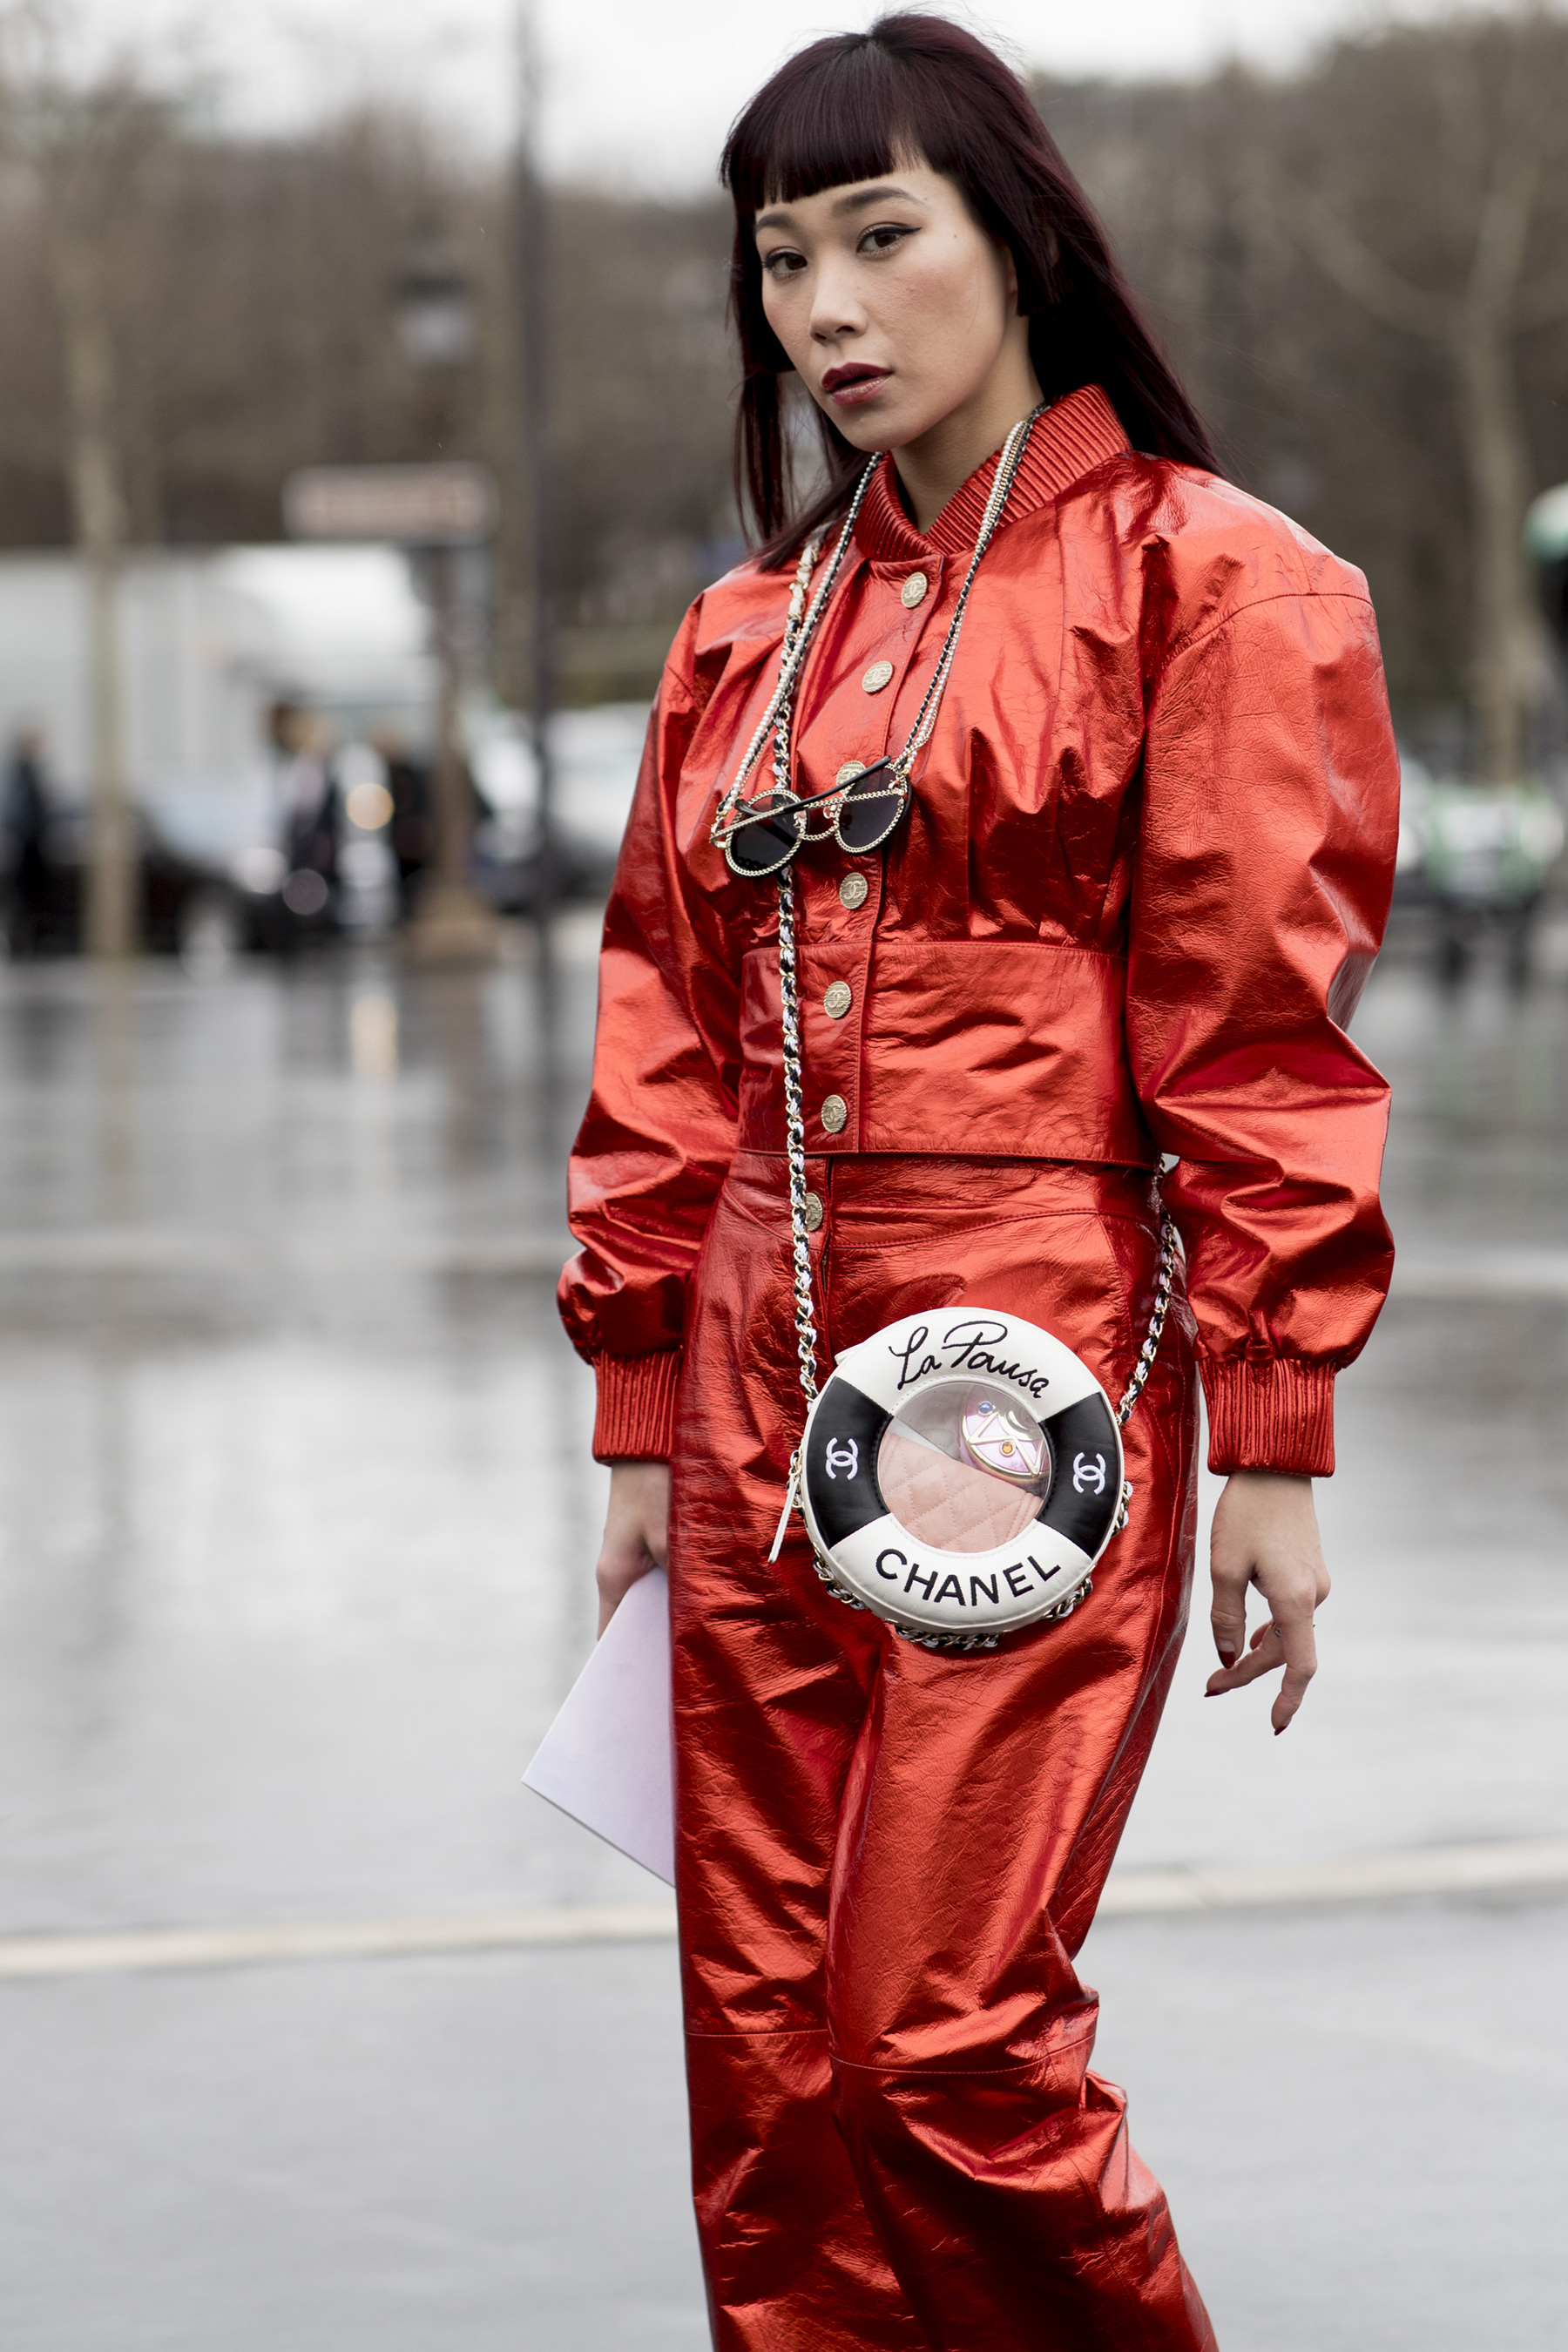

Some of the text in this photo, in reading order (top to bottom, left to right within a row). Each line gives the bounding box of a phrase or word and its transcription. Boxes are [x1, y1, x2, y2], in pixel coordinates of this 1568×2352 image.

[889, 1321, 1050, 1398] La Pausa
[876, 1549, 1061, 1606] CHANEL
